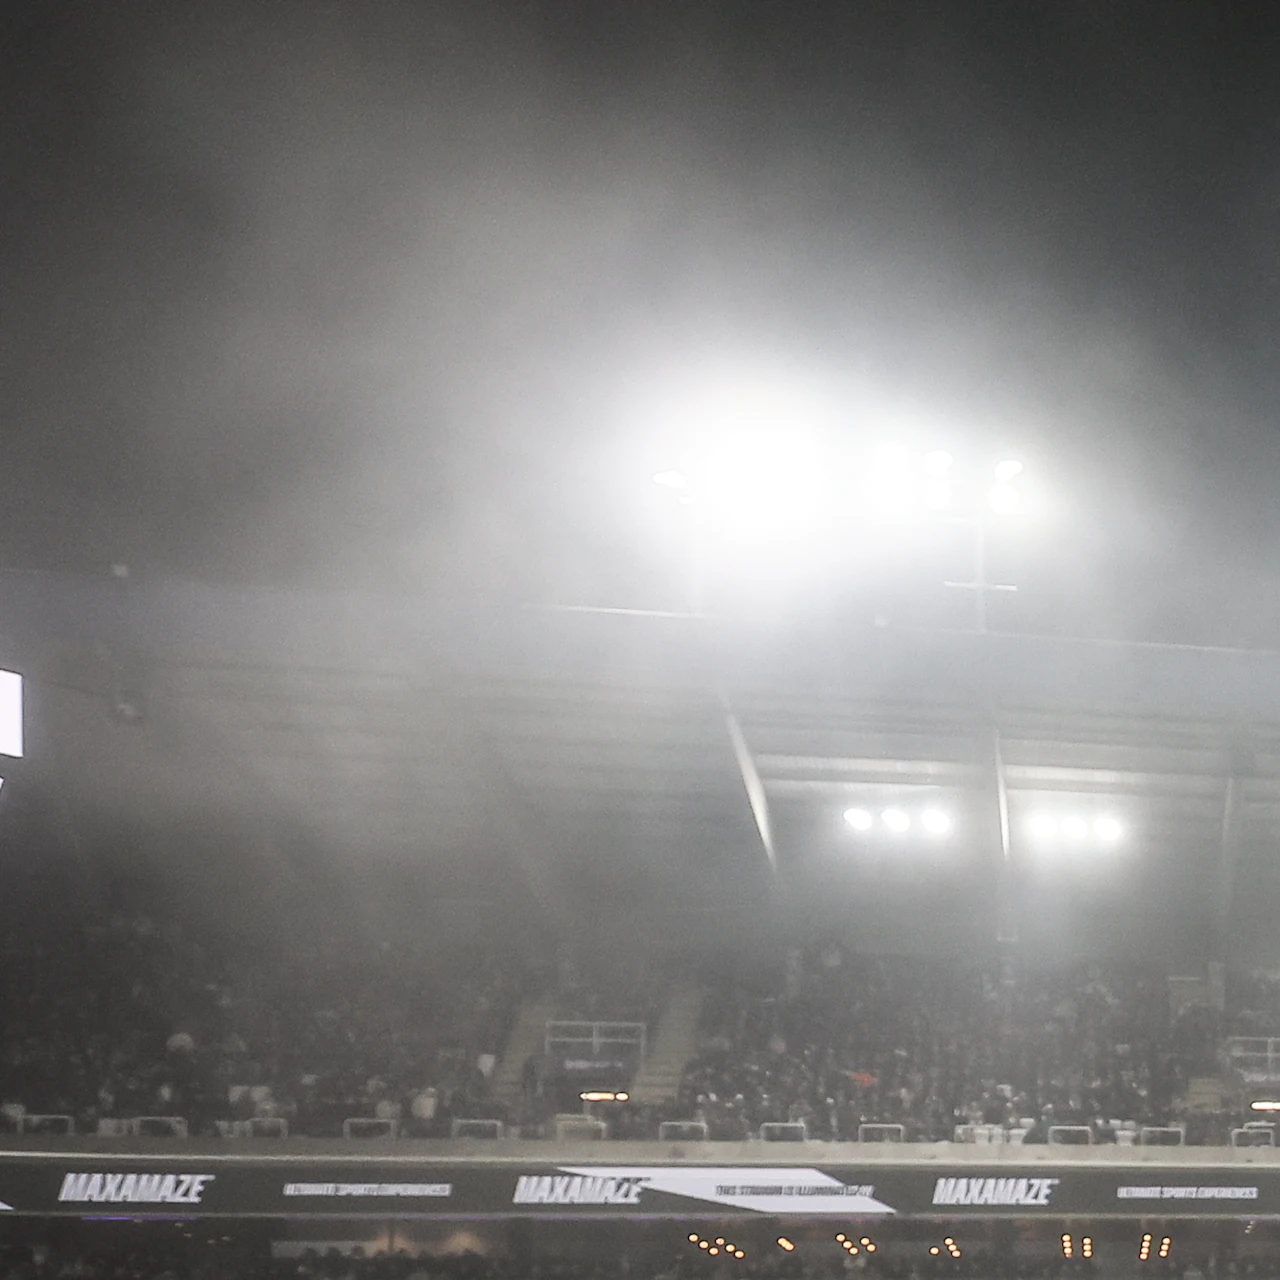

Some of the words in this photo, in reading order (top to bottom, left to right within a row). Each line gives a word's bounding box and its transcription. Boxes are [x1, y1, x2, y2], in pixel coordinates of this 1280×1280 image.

[58, 1173, 213, 1203] MAXAMAZE
[512, 1176, 644, 1204] MAXAMAZE
[932, 1178, 1058, 1205] MAXAMAZE
